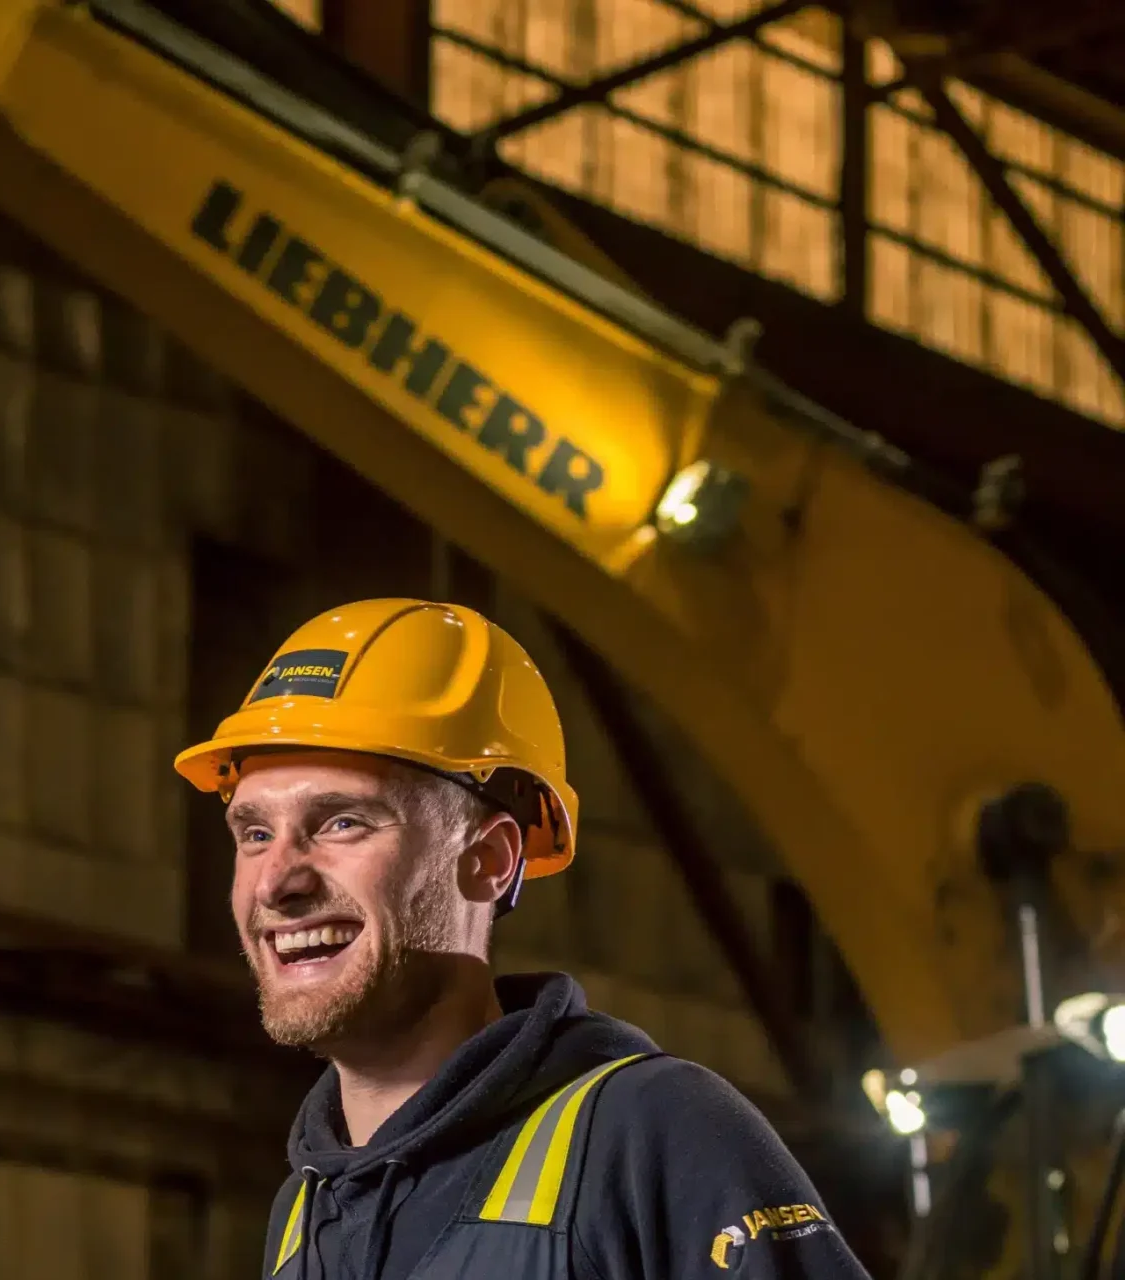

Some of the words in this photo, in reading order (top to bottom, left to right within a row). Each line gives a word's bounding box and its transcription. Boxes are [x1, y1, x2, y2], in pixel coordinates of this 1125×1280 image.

[192, 179, 604, 522] LIEBHERR
[279, 665, 334, 680] JANSEN
[742, 1203, 825, 1240] JANSEN
